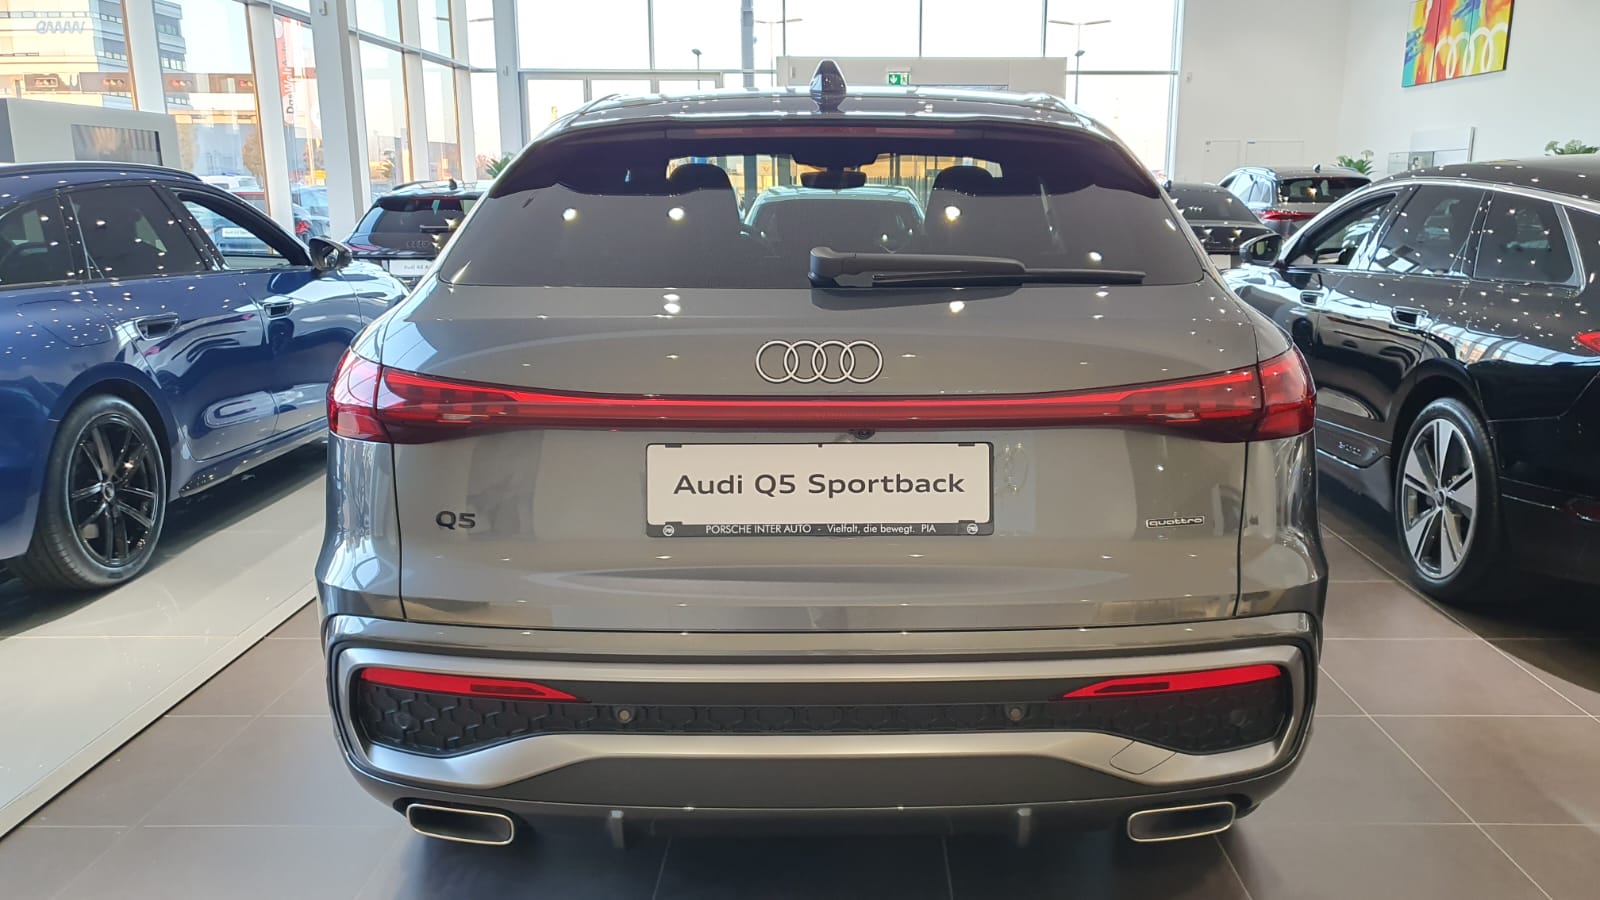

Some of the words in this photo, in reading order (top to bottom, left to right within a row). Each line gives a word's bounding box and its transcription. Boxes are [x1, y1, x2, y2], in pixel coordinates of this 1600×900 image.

[673, 474, 743, 495] Audi
[754, 474, 796, 498] Q5
[808, 473, 966, 499] Sportback
[436, 511, 476, 530] Q5
[1149, 518, 1203, 527] quattro
[705, 524, 752, 535] PORSCHE
[754, 524, 781, 534] INTER
[783, 524, 812, 534] AUTO
[827, 523, 861, 535] Vielfalt,
[863, 523, 877, 533] die
[880, 523, 915, 535] bewegt.
[921, 523, 937, 533] PIA
